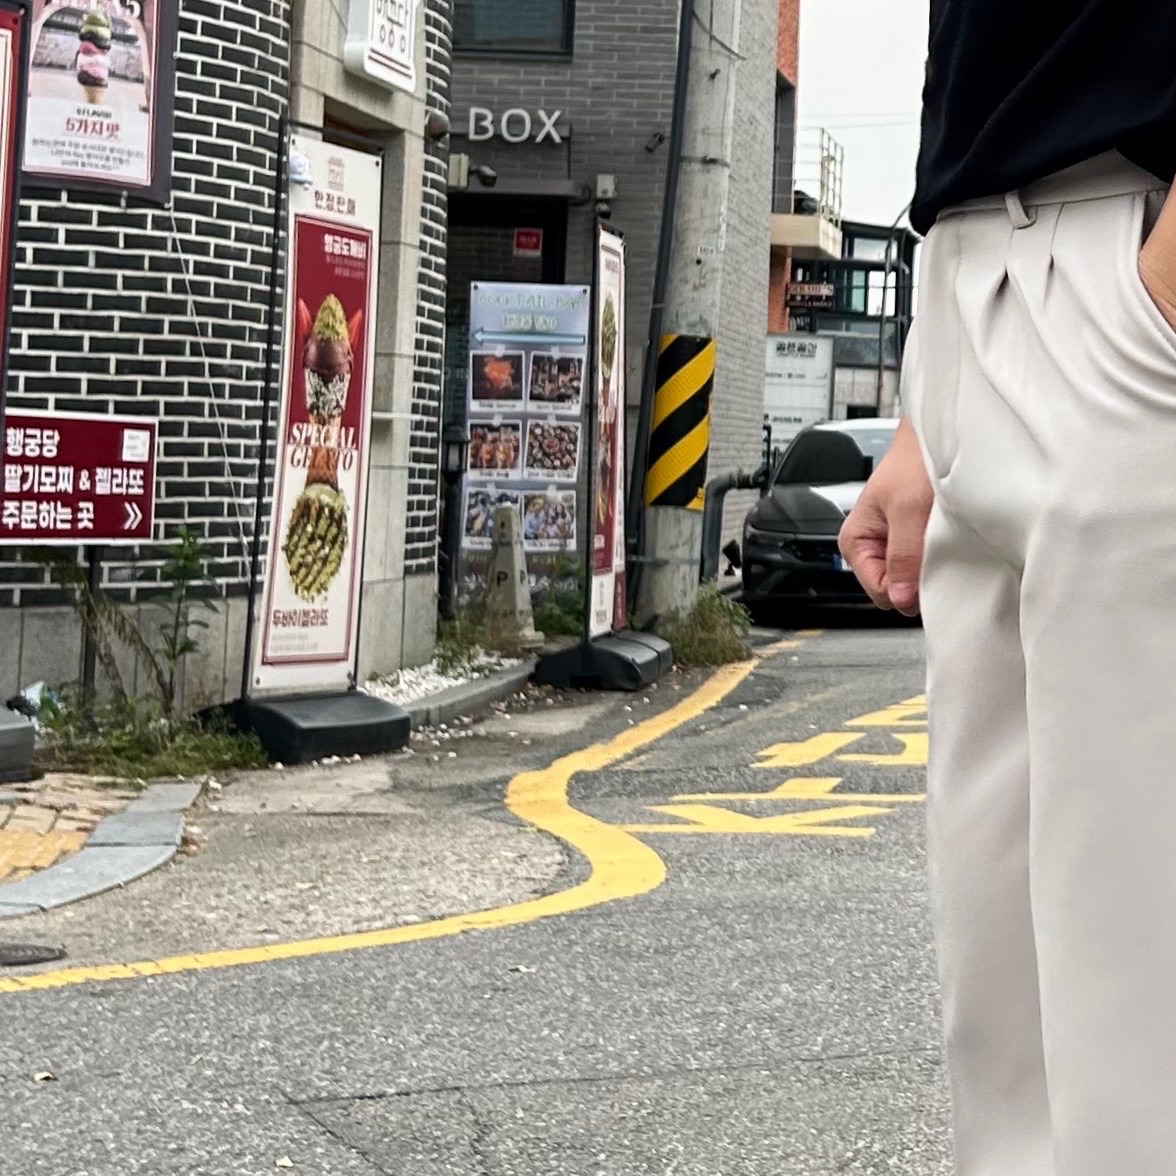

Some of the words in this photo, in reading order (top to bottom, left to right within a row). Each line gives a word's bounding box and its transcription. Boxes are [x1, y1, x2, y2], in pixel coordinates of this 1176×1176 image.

[468, 107, 563, 144] BOX
[6, 427, 60, 458] 행궁당
[4, 463, 74, 494] 딸기모찌
[79, 468, 91, 491] &
[95, 466, 145, 496] 젤라또
[2, 500, 72, 530] 주문하는
[77, 501, 94, 530] 곳
